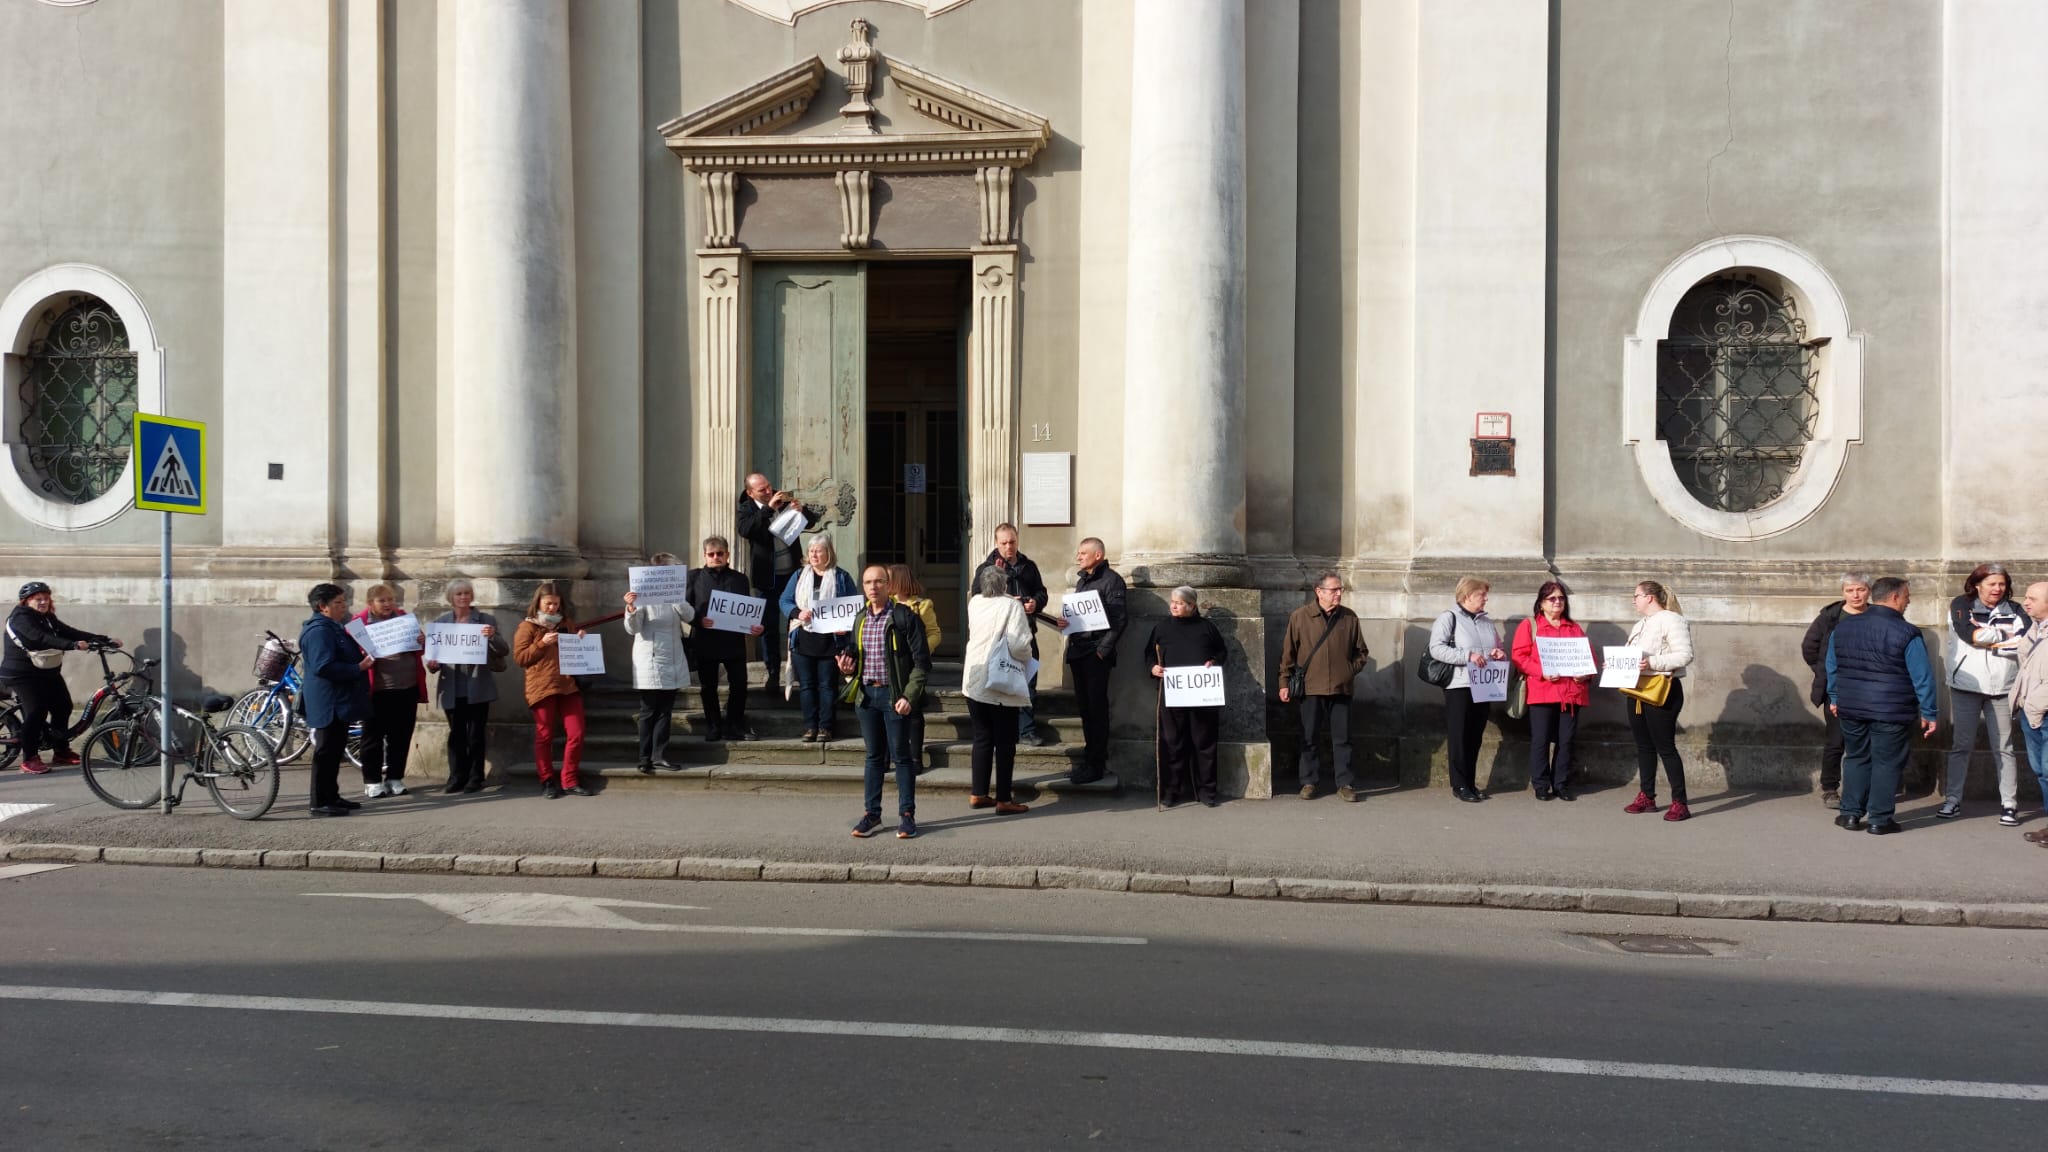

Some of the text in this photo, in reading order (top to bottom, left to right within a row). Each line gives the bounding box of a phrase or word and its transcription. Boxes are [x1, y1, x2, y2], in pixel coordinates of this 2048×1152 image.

[1031, 421, 1052, 442] 14
[710, 597, 762, 618] NE LOPJ!
[1072, 599, 1102, 616] LOPJ!
[445, 633, 458, 646] NU
[1166, 673, 1221, 689] NE LOPJ!
[1479, 668, 1507, 684] LOPJ!
